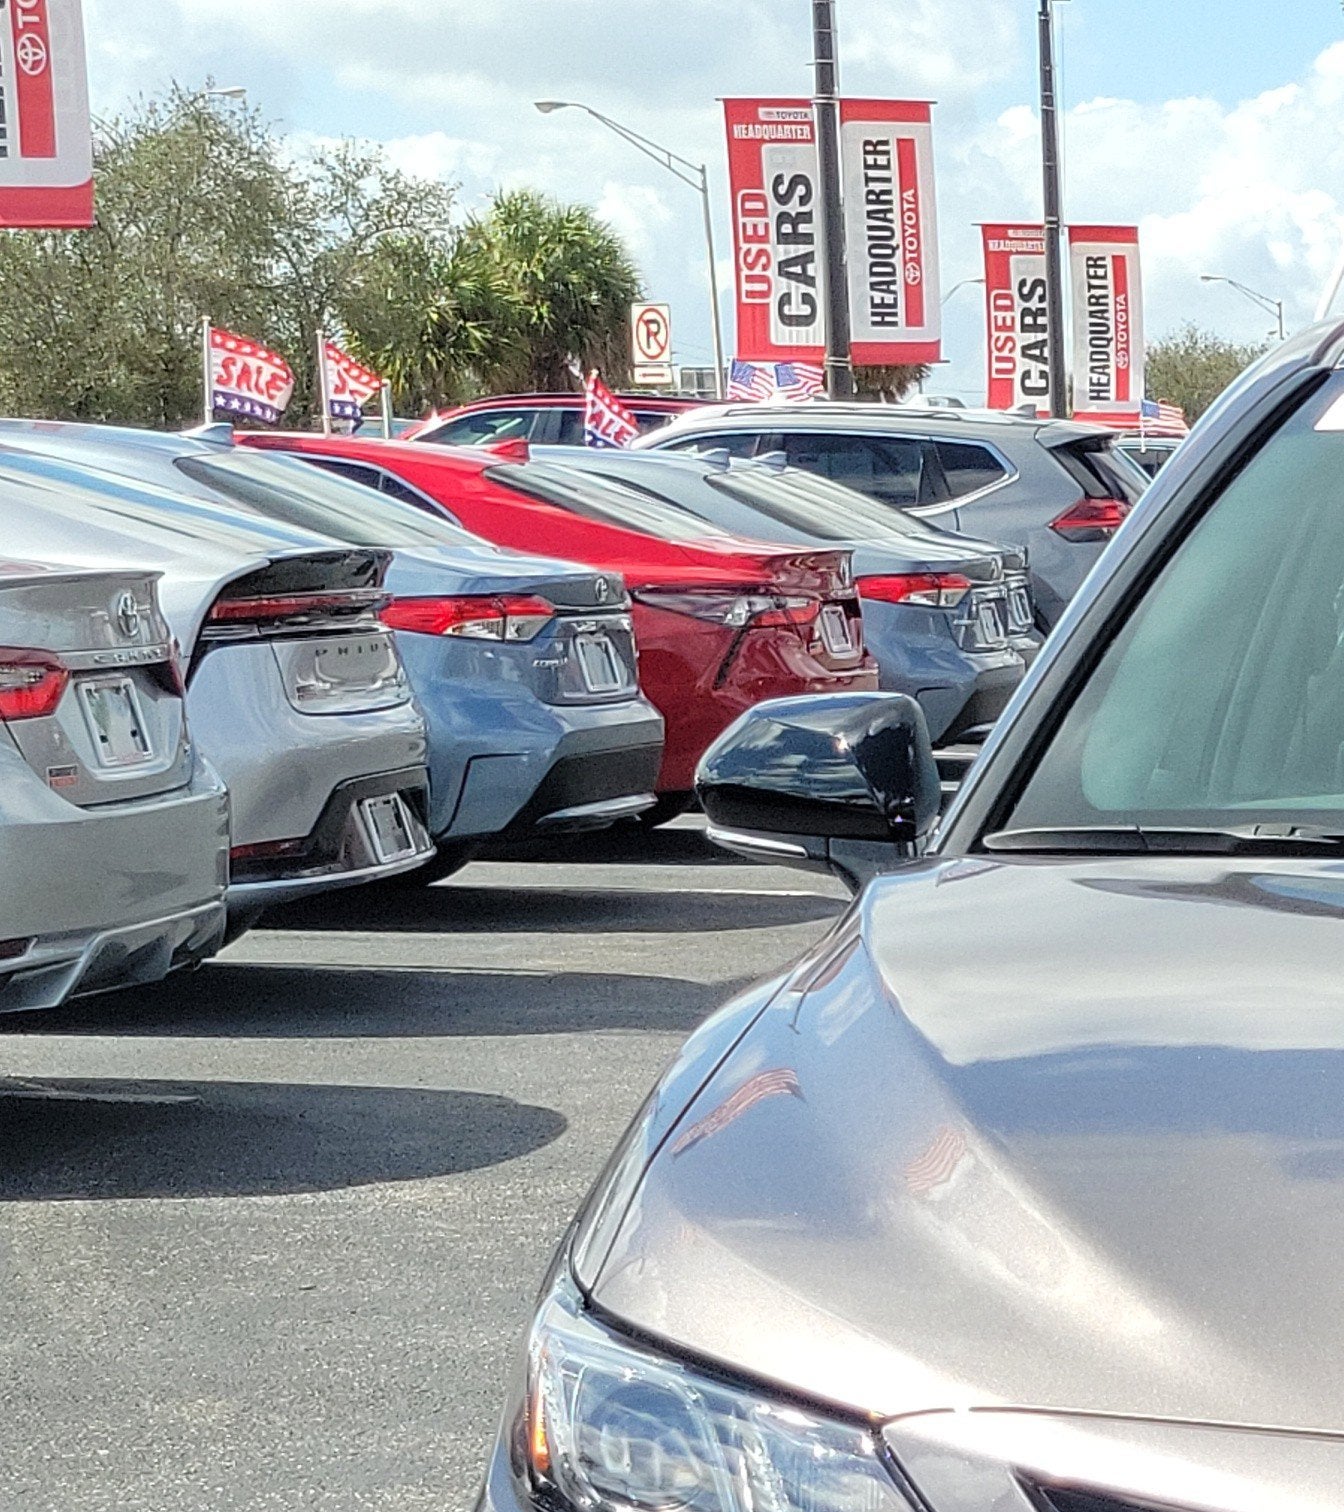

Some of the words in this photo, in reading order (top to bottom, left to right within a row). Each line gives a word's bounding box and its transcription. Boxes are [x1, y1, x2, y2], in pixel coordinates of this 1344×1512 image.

[733, 123, 812, 140] HEADQUARTER
[741, 192, 773, 300] USED
[772, 173, 818, 327] CARS
[863, 138, 899, 327] HEADQUARTER
[903, 189, 920, 257] TOYOTA
[994, 292, 1016, 376] USED
[1018, 278, 1049, 396] CARS
[1086, 256, 1113, 401] HEADQUARTER
[1115, 294, 1127, 347] TOYOTA
[216, 357, 289, 400] SALE
[588, 402, 632, 446] ALE
